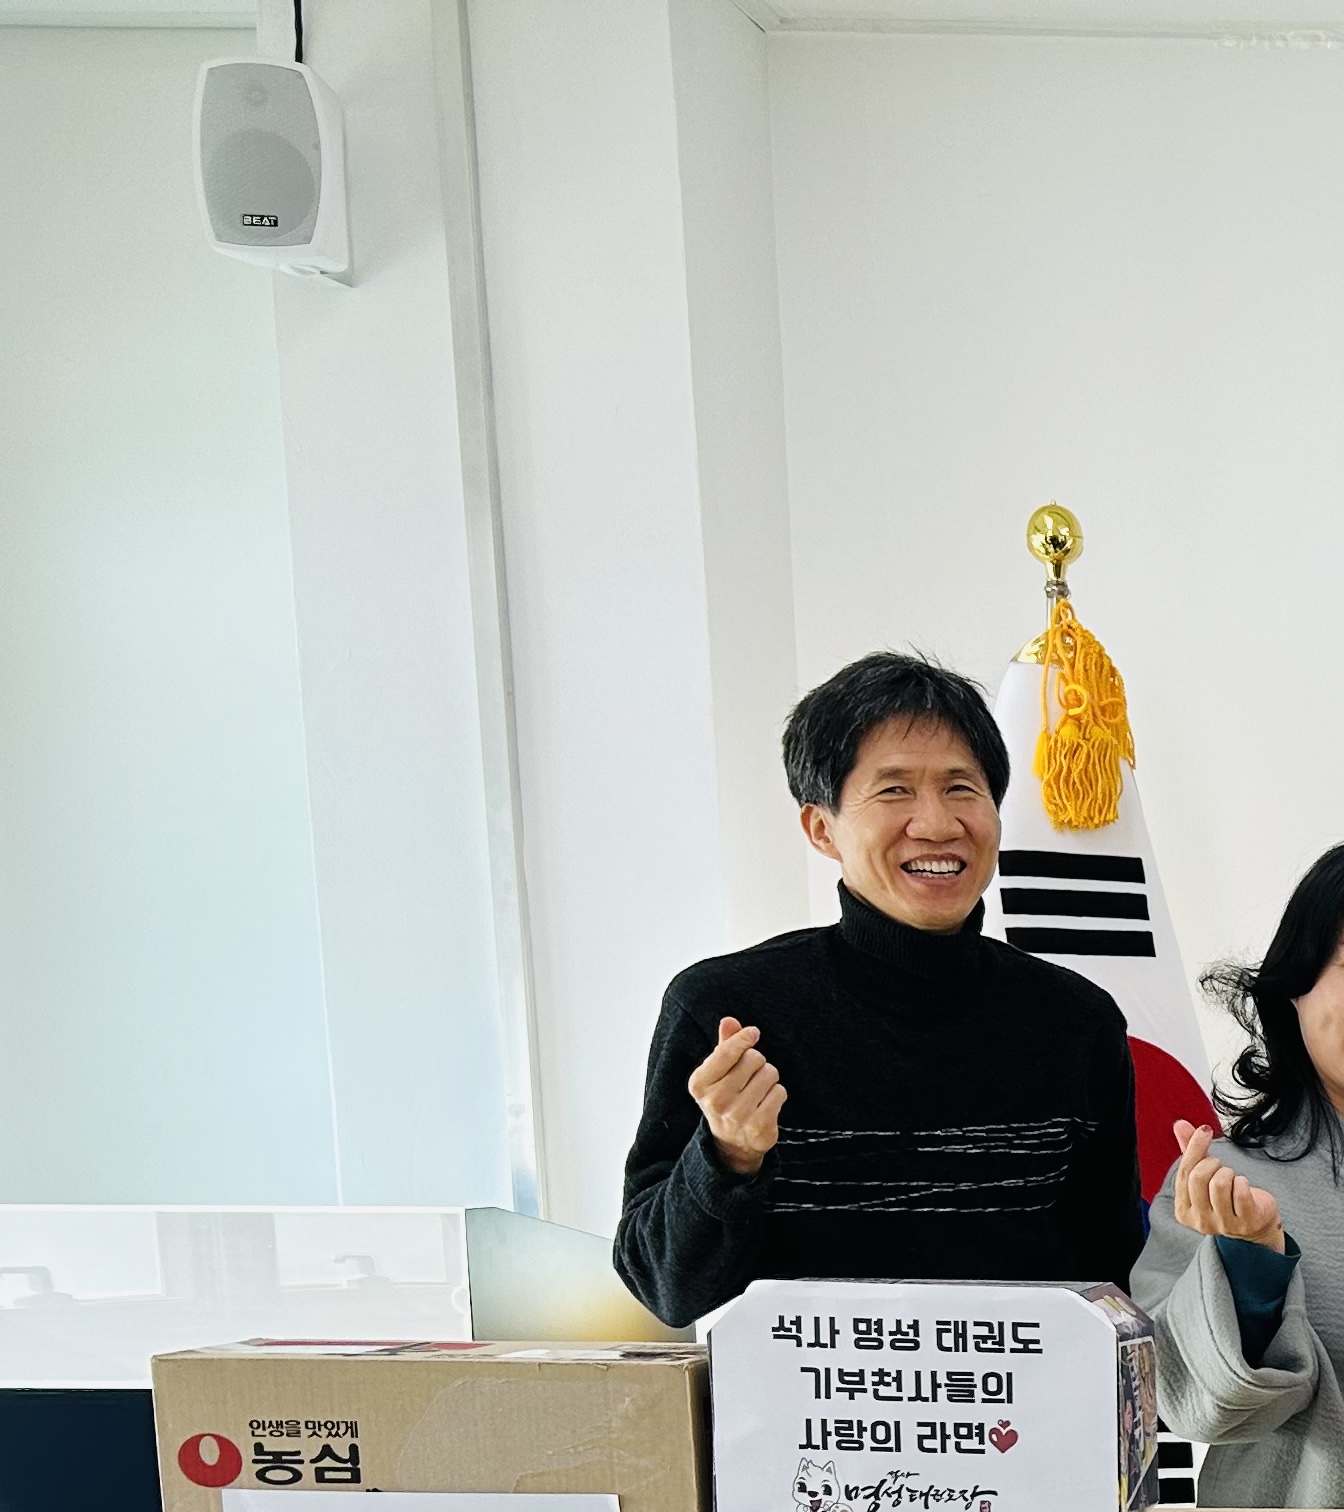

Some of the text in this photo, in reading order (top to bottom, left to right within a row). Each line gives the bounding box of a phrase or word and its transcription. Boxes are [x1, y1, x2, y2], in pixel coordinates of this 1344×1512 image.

[243, 215, 278, 227] BEAT
[772, 1315, 1043, 1354] 석사 명성 태권도
[801, 1367, 1013, 1404] 기부천사들의
[249, 1419, 359, 1439] 인생을 맛있게
[799, 1419, 988, 1455] 사랑의 라면
[252, 1441, 362, 1485] 농심
